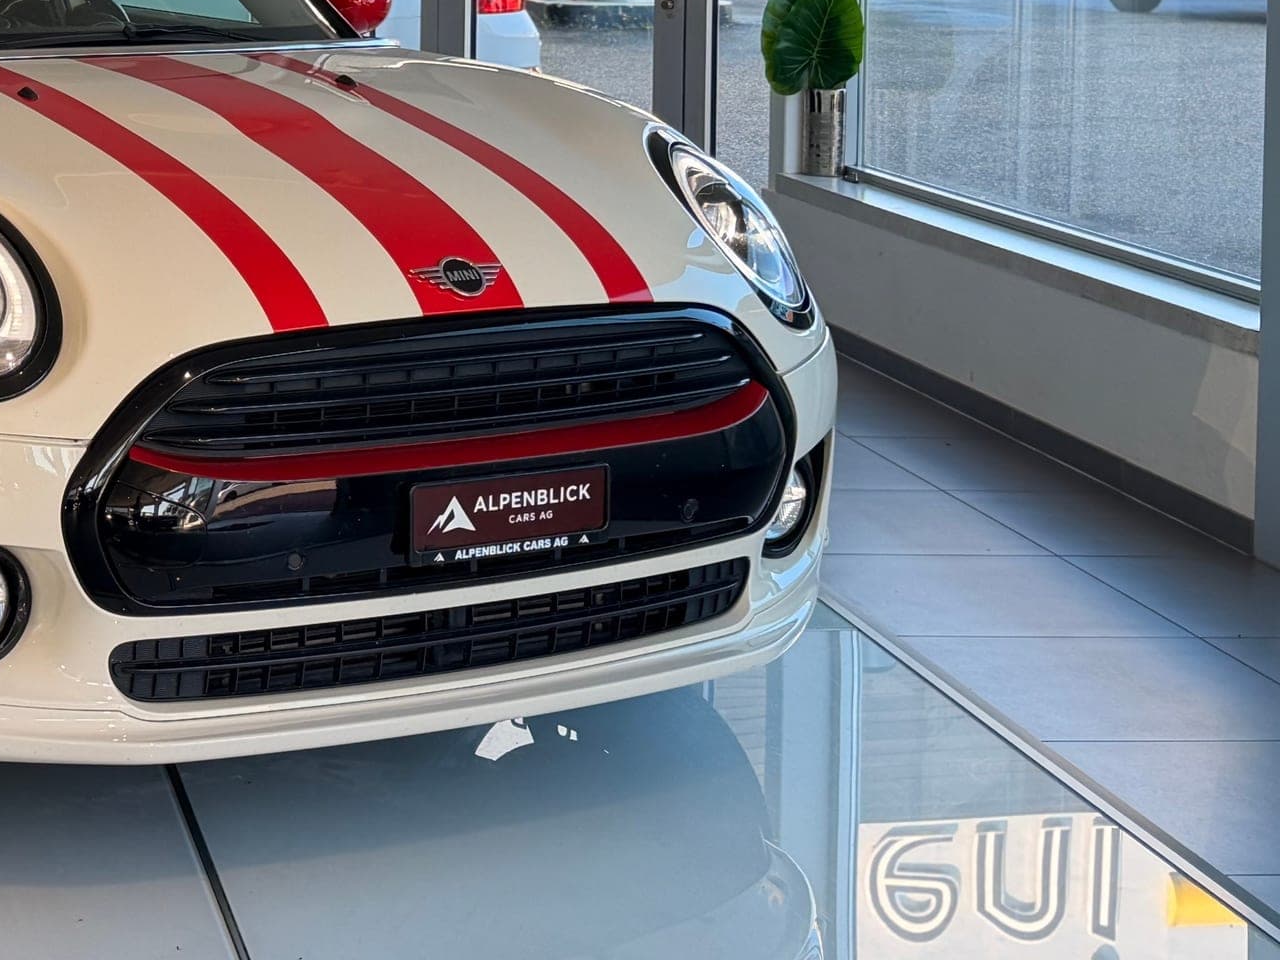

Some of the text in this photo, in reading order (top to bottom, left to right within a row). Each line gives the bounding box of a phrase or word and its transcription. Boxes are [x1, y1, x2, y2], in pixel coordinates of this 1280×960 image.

[446, 269, 480, 281] MINI
[473, 483, 592, 513] ALPENBLICK
[508, 510, 554, 524] CARS AG
[454, 536, 569, 561] ALPENBLICK CARS AG
